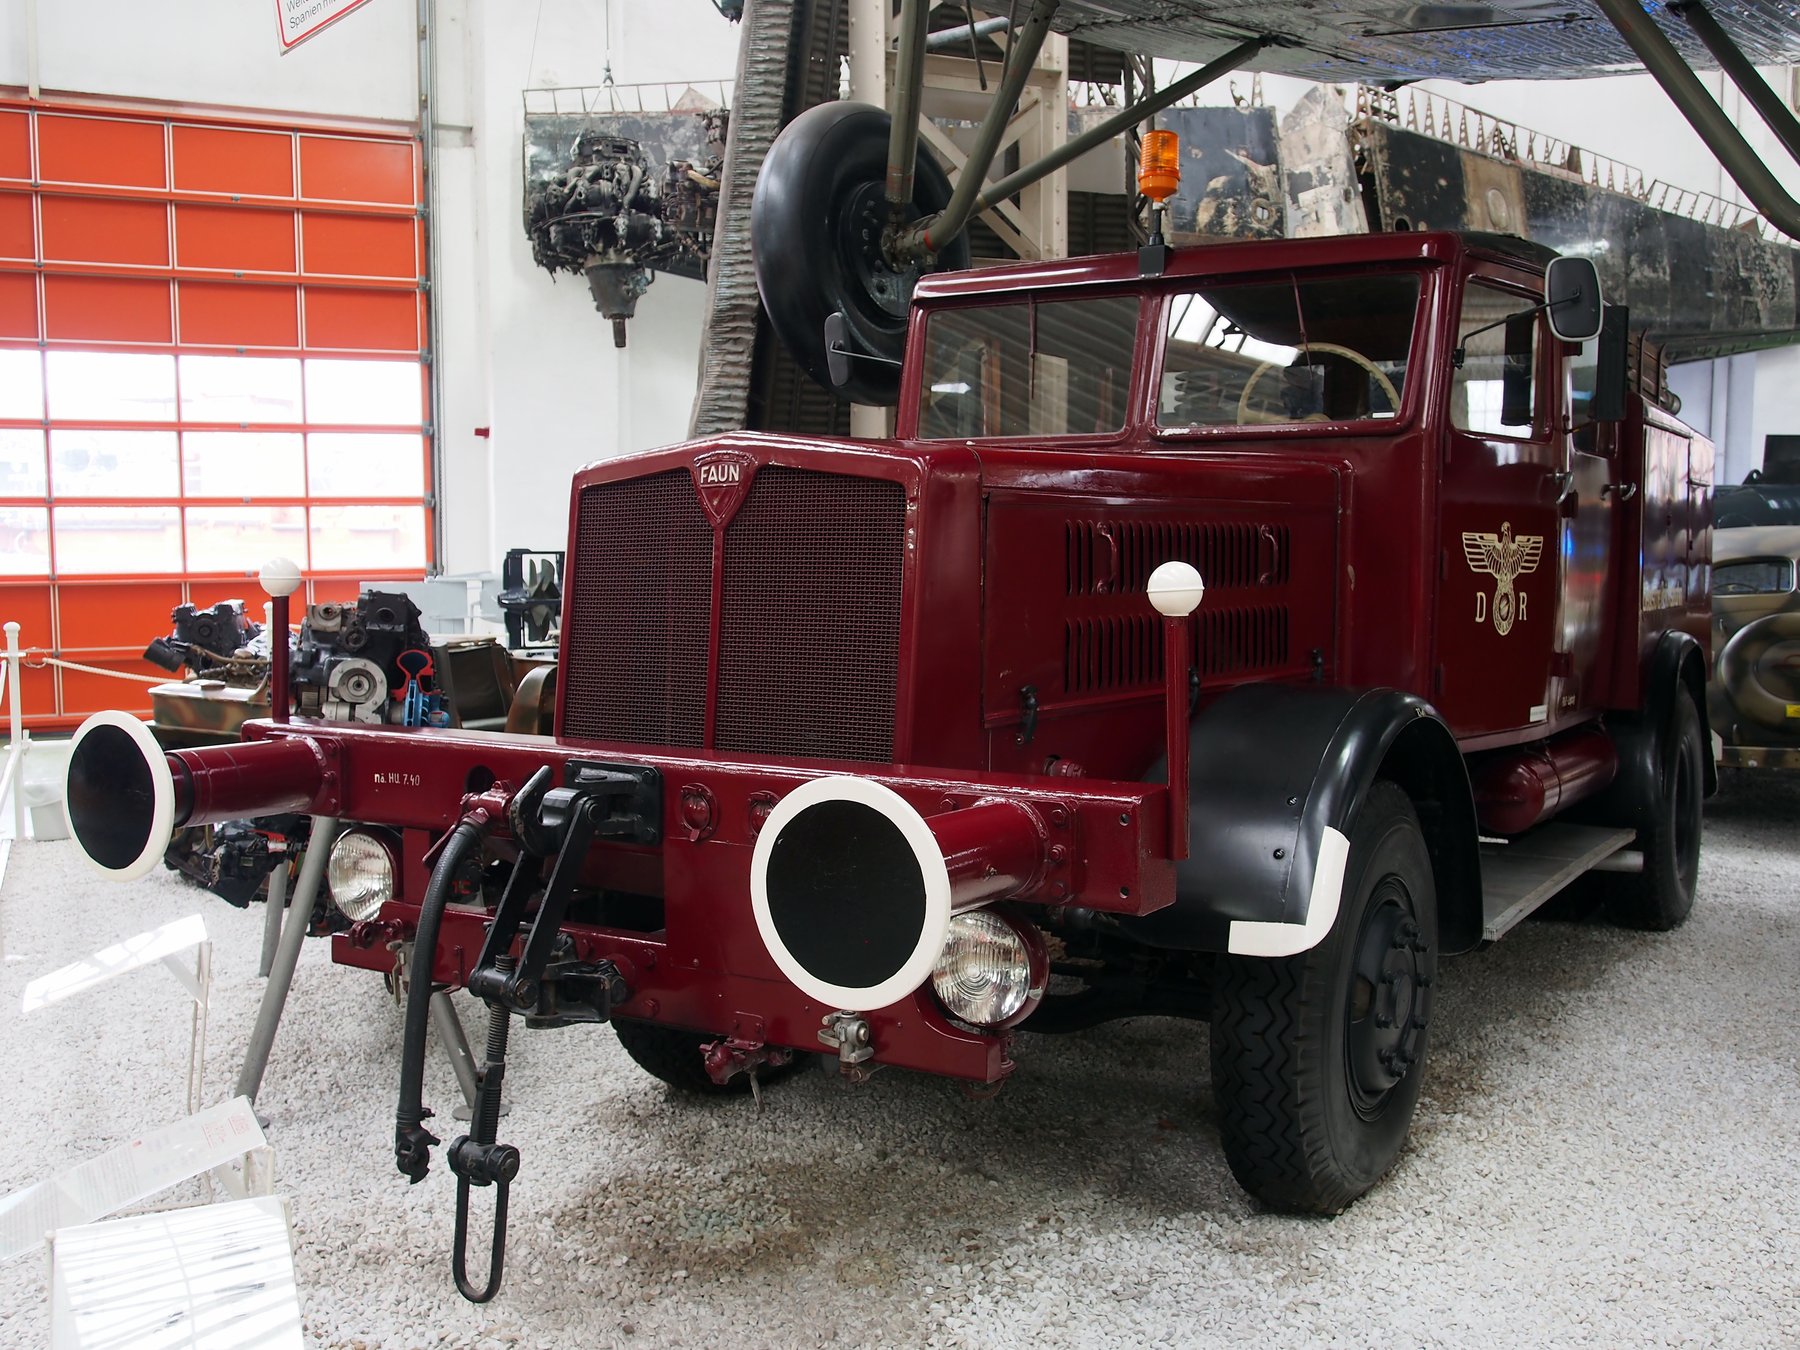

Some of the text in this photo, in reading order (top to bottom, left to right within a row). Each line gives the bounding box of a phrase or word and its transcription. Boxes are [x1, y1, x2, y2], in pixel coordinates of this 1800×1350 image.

[289, 3, 322, 29] Spanien
[700, 464, 740, 484] FAUN
[1475, 591, 1528, 623] D R
[402, 773, 420, 787] 7.40
